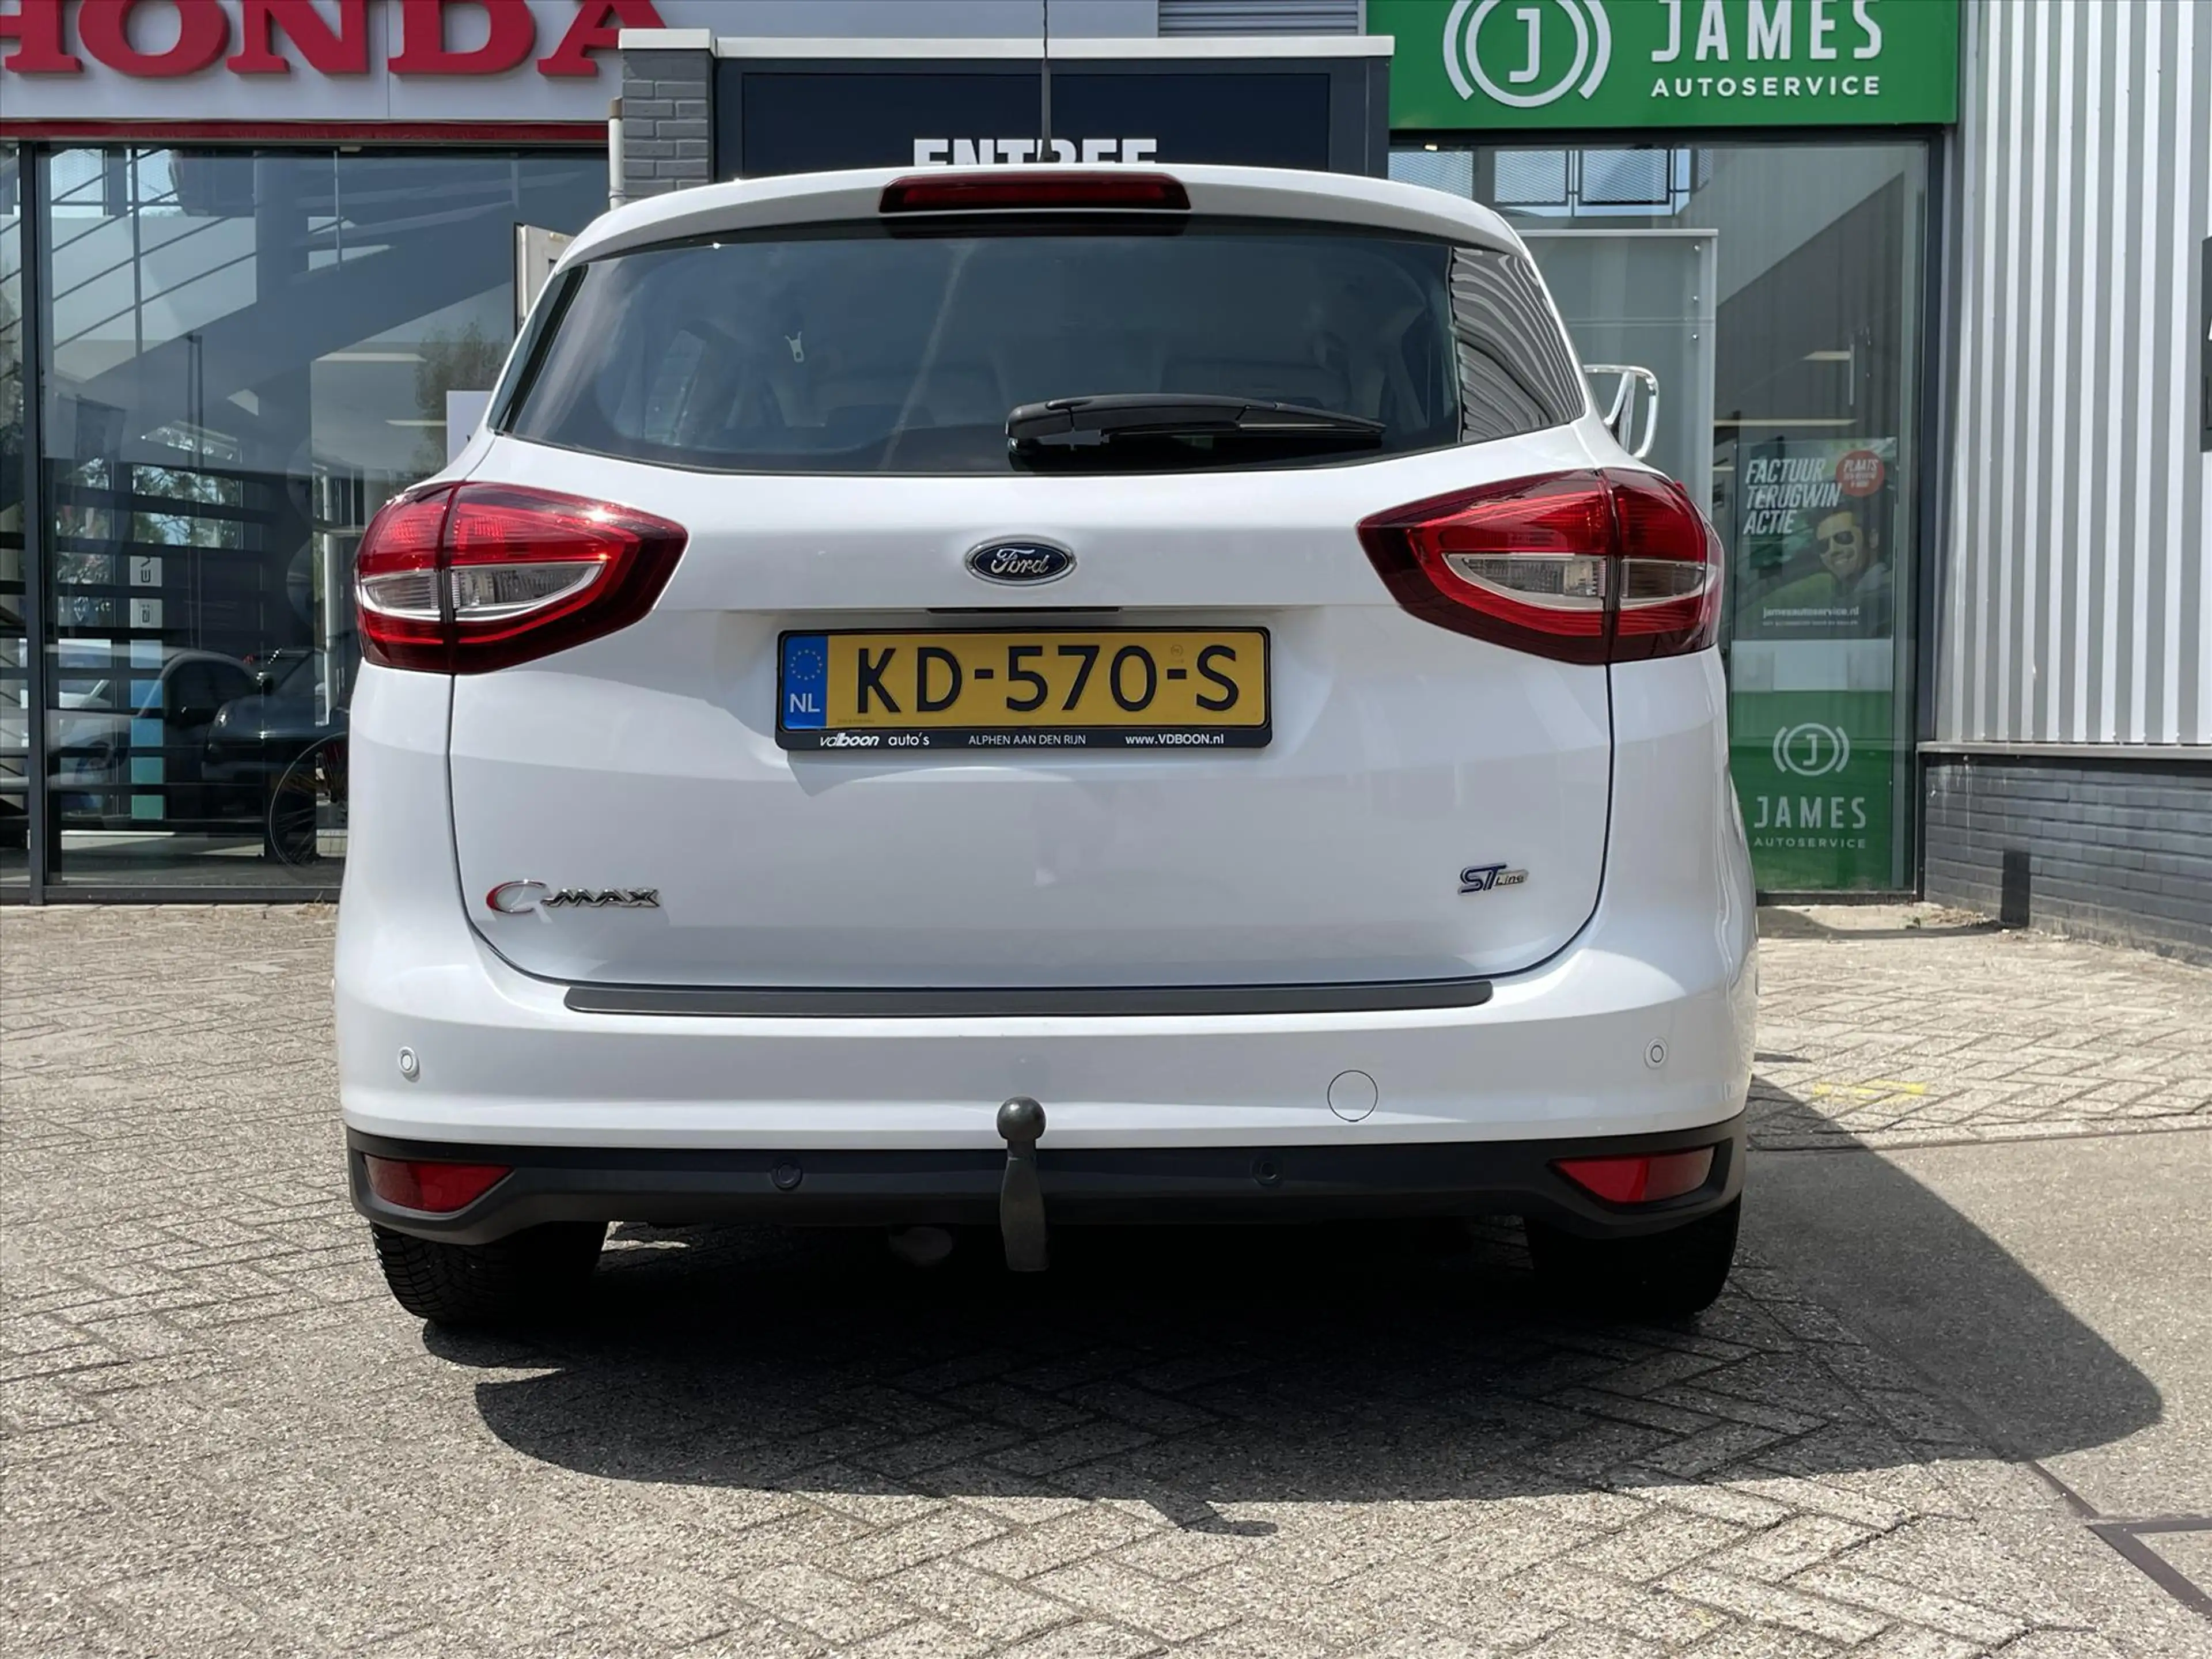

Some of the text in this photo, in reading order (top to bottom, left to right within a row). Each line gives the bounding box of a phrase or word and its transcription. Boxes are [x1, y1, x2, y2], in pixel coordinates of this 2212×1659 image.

[1652, 0, 1882, 62] JAMES
[1652, 76, 1880, 97] AUTOSERVICE
[1745, 459, 1825, 484] FACTUUR
[1747, 483, 1842, 509] TERUGWIN
[1743, 510, 1797, 535] ACTIE
[990, 548, 1050, 574] Ford
[857, 644, 1240, 714] KD-570-S
[790, 693, 820, 713] NL
[888, 732, 930, 746] auto's
[968, 734, 1086, 745] ALPHEN AAN DEN RIJN
[1125, 733, 1224, 744] www.VDBOON.nl
[1753, 796, 1866, 829] JAMES
[1753, 837, 1866, 849] AUTOSERVICE
